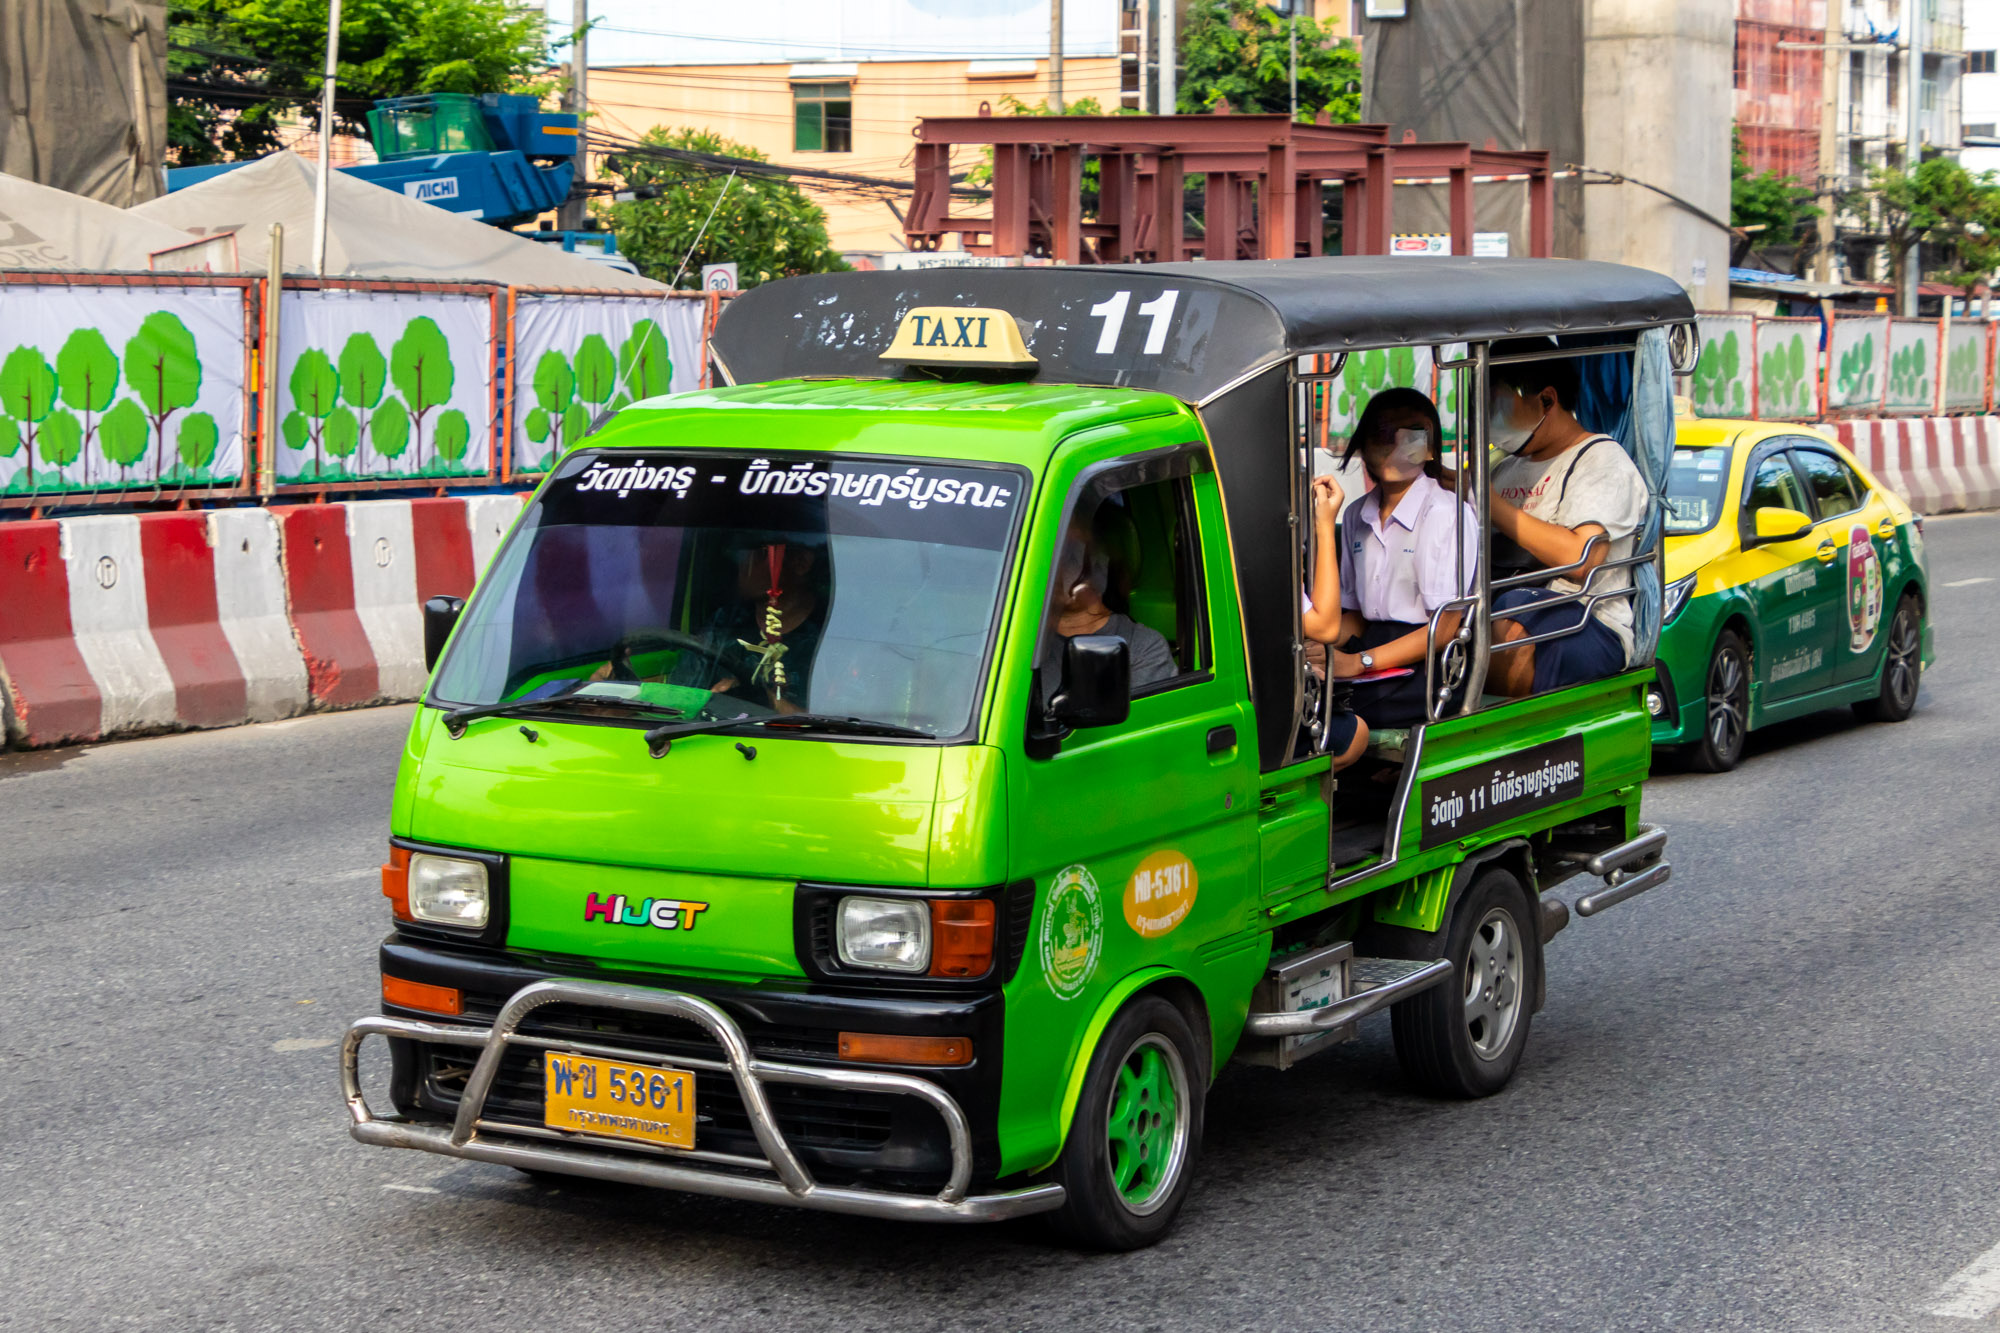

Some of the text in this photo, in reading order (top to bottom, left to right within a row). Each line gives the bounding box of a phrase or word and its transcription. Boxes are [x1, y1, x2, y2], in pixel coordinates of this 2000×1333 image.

[416, 181, 455, 199] AICHI
[711, 278, 729, 290] 30
[910, 315, 990, 348] TAXI
[1090, 290, 1179, 354] 11
[576, 459, 696, 499] วัดทุ่งครุ
[1431, 790, 1464, 828] วัดทุ่ง
[1470, 785, 1485, 812] 11
[584, 892, 709, 930] HIJET
[609, 1066, 684, 1113] 5361
[568, 1108, 671, 1135] กรุงเทพมหานคร
